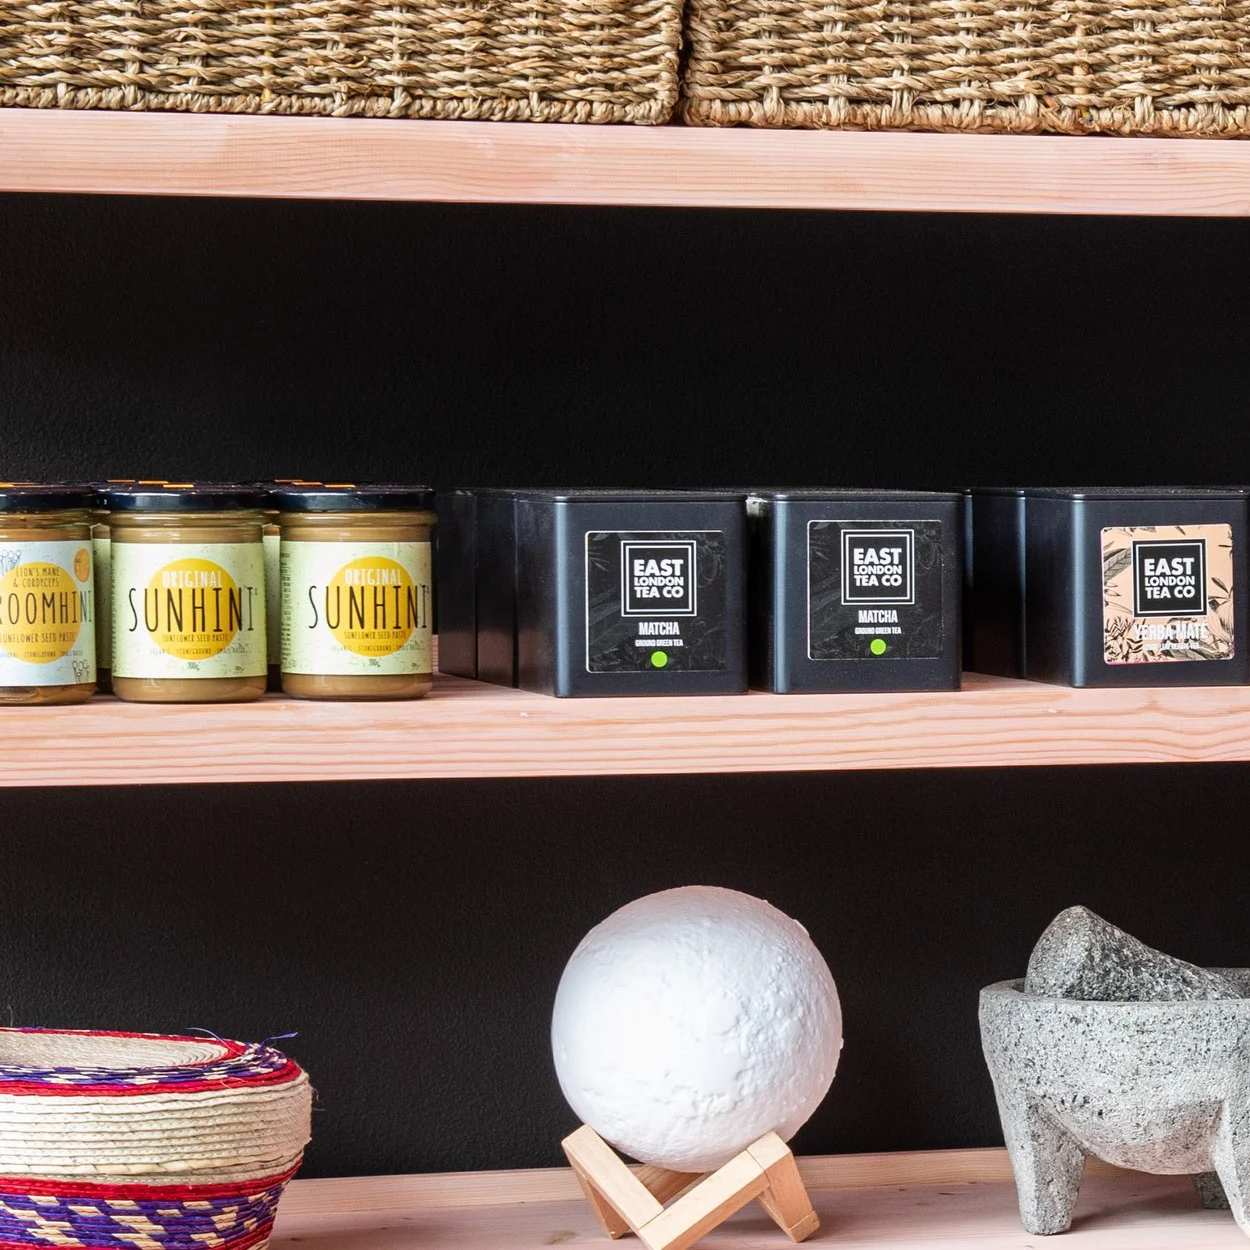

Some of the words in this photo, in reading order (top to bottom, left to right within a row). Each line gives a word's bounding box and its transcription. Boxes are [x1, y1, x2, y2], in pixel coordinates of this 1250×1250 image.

[853, 548, 902, 565] EAST
[634, 559, 684, 576] EAST
[853, 565, 902, 575] LONDON
[1144, 558, 1195, 576] EAST
[162, 570, 224, 588] ORIGINAL
[344, 568, 402, 586] ORIGINAL
[634, 576, 684, 586] LONDON
[853, 575, 879, 587] TEA
[881, 574, 902, 587] CO
[1144, 575, 1195, 587] LONDON
[634, 586, 660, 598] TEA
[662, 586, 684, 598] CO
[1145, 586, 1171, 599] TEA
[1174, 585, 1196, 598] CO
[0, 590, 92, 625] OOMHINI
[858, 610, 898, 623] MATCHA
[638, 622, 680, 635] MATCHA
[1134, 623, 1174, 640] YERBA
[41, 632, 57, 643] SEED
[196, 633, 211, 642] SEED
[212, 633, 229, 642] PASTE
[673, 639, 683, 647] TEA
